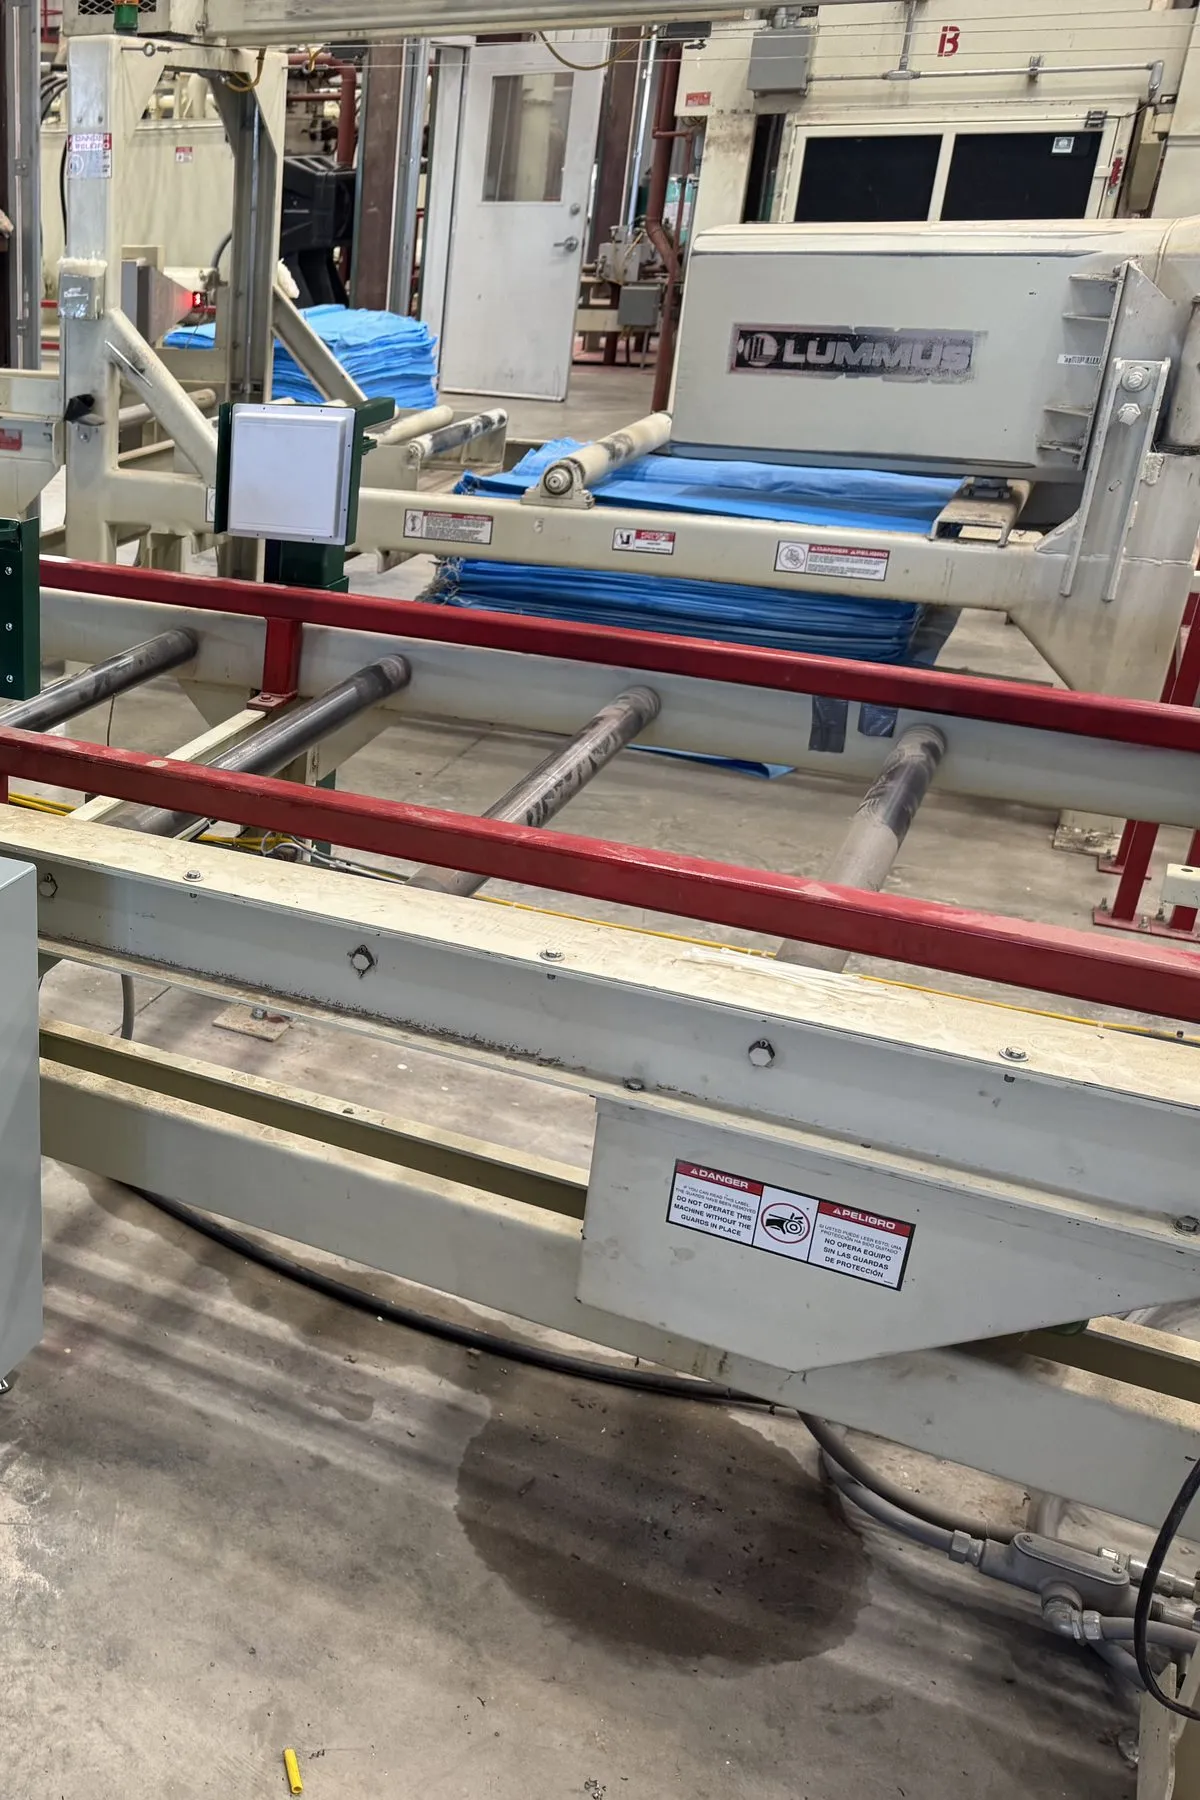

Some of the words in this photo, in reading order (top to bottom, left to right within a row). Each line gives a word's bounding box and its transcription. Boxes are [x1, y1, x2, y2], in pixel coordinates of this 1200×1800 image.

[937, 25, 960, 57] B
[783, 338, 973, 370] LUMMUS
[699, 1169, 749, 1189] DANGER
[686, 1191, 704, 1199] GUARDS
[733, 1203, 756, 1214] REMOVED
[688, 1198, 701, 1206] NOT
[704, 1202, 734, 1216] OPERATE
[736, 1212, 751, 1221] THIS
[674, 1203, 704, 1216] MACHINE
[706, 1212, 736, 1225] WITHOUT
[738, 1221, 751, 1230] THE
[681, 1214, 709, 1226] GUARDS
[719, 1225, 741, 1236] PLACE
[842, 1210, 896, 1230] PELIGRO
[825, 1225, 841, 1234] USTED
[843, 1230, 859, 1239] PUEDE
[824, 1247, 835, 1255] SIN
[837, 1250, 851, 1259] LAS
[853, 1255, 889, 1270] GUARDAS
[837, 1241, 862, 1253] OPERA
[863, 1249, 892, 1261] EQUIPO
[875, 1244, 898, 1255] QUITADO
[836, 1259, 883, 1278] PROTECCIÓN
